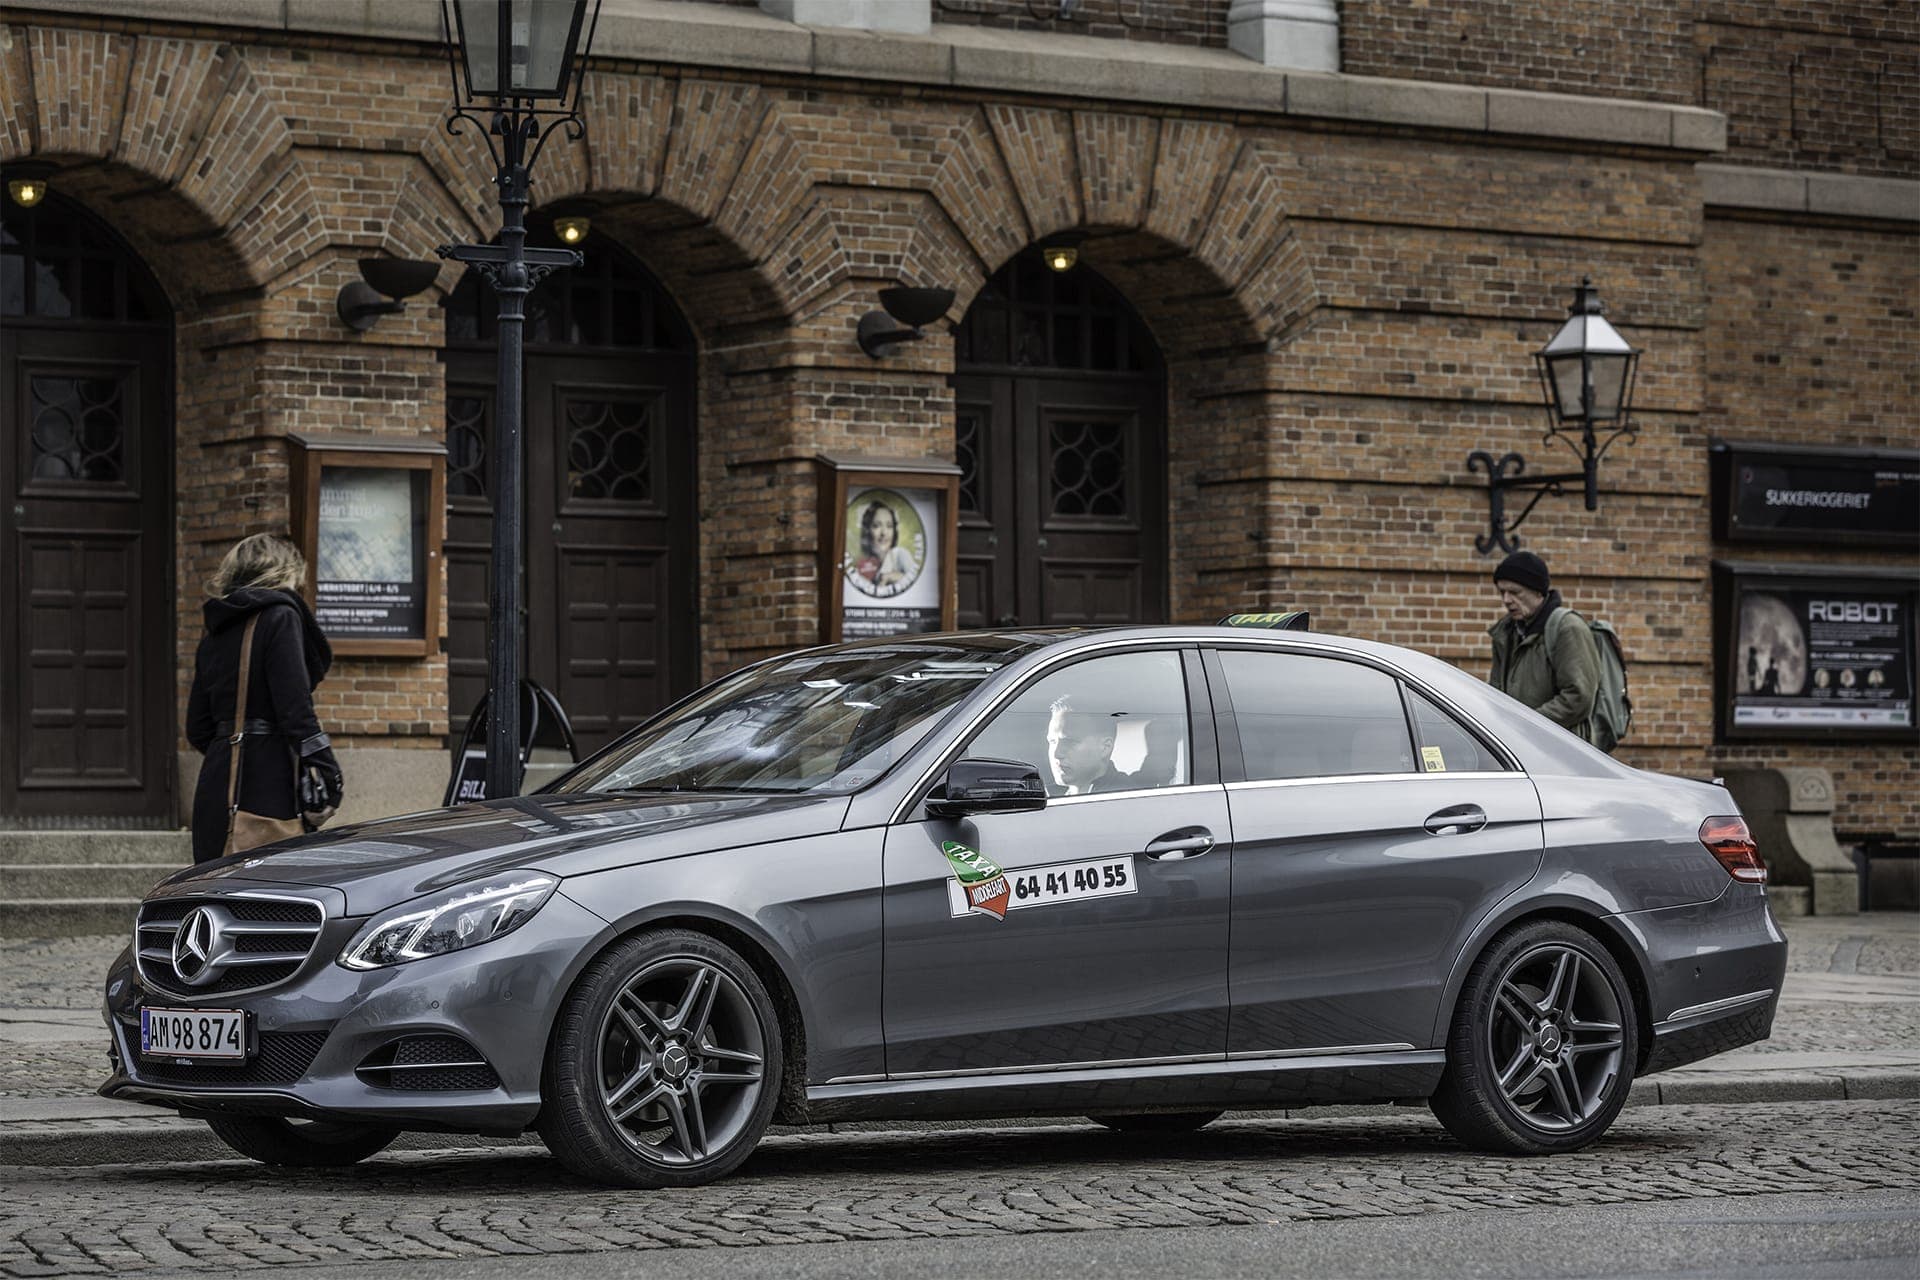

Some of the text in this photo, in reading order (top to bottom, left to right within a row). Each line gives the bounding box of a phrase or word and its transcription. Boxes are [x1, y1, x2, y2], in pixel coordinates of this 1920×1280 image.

[1766, 489, 1870, 508] SUKKERKOGERIET
[1809, 601, 1898, 623] ROBOT
[949, 844, 996, 877] TAXA
[972, 877, 1007, 905] MIDDELFART
[1015, 864, 1127, 899] 64 41 40 55
[150, 1016, 169, 1048] AM
[172, 1017, 194, 1050] 98
[199, 1017, 240, 1050] 874
